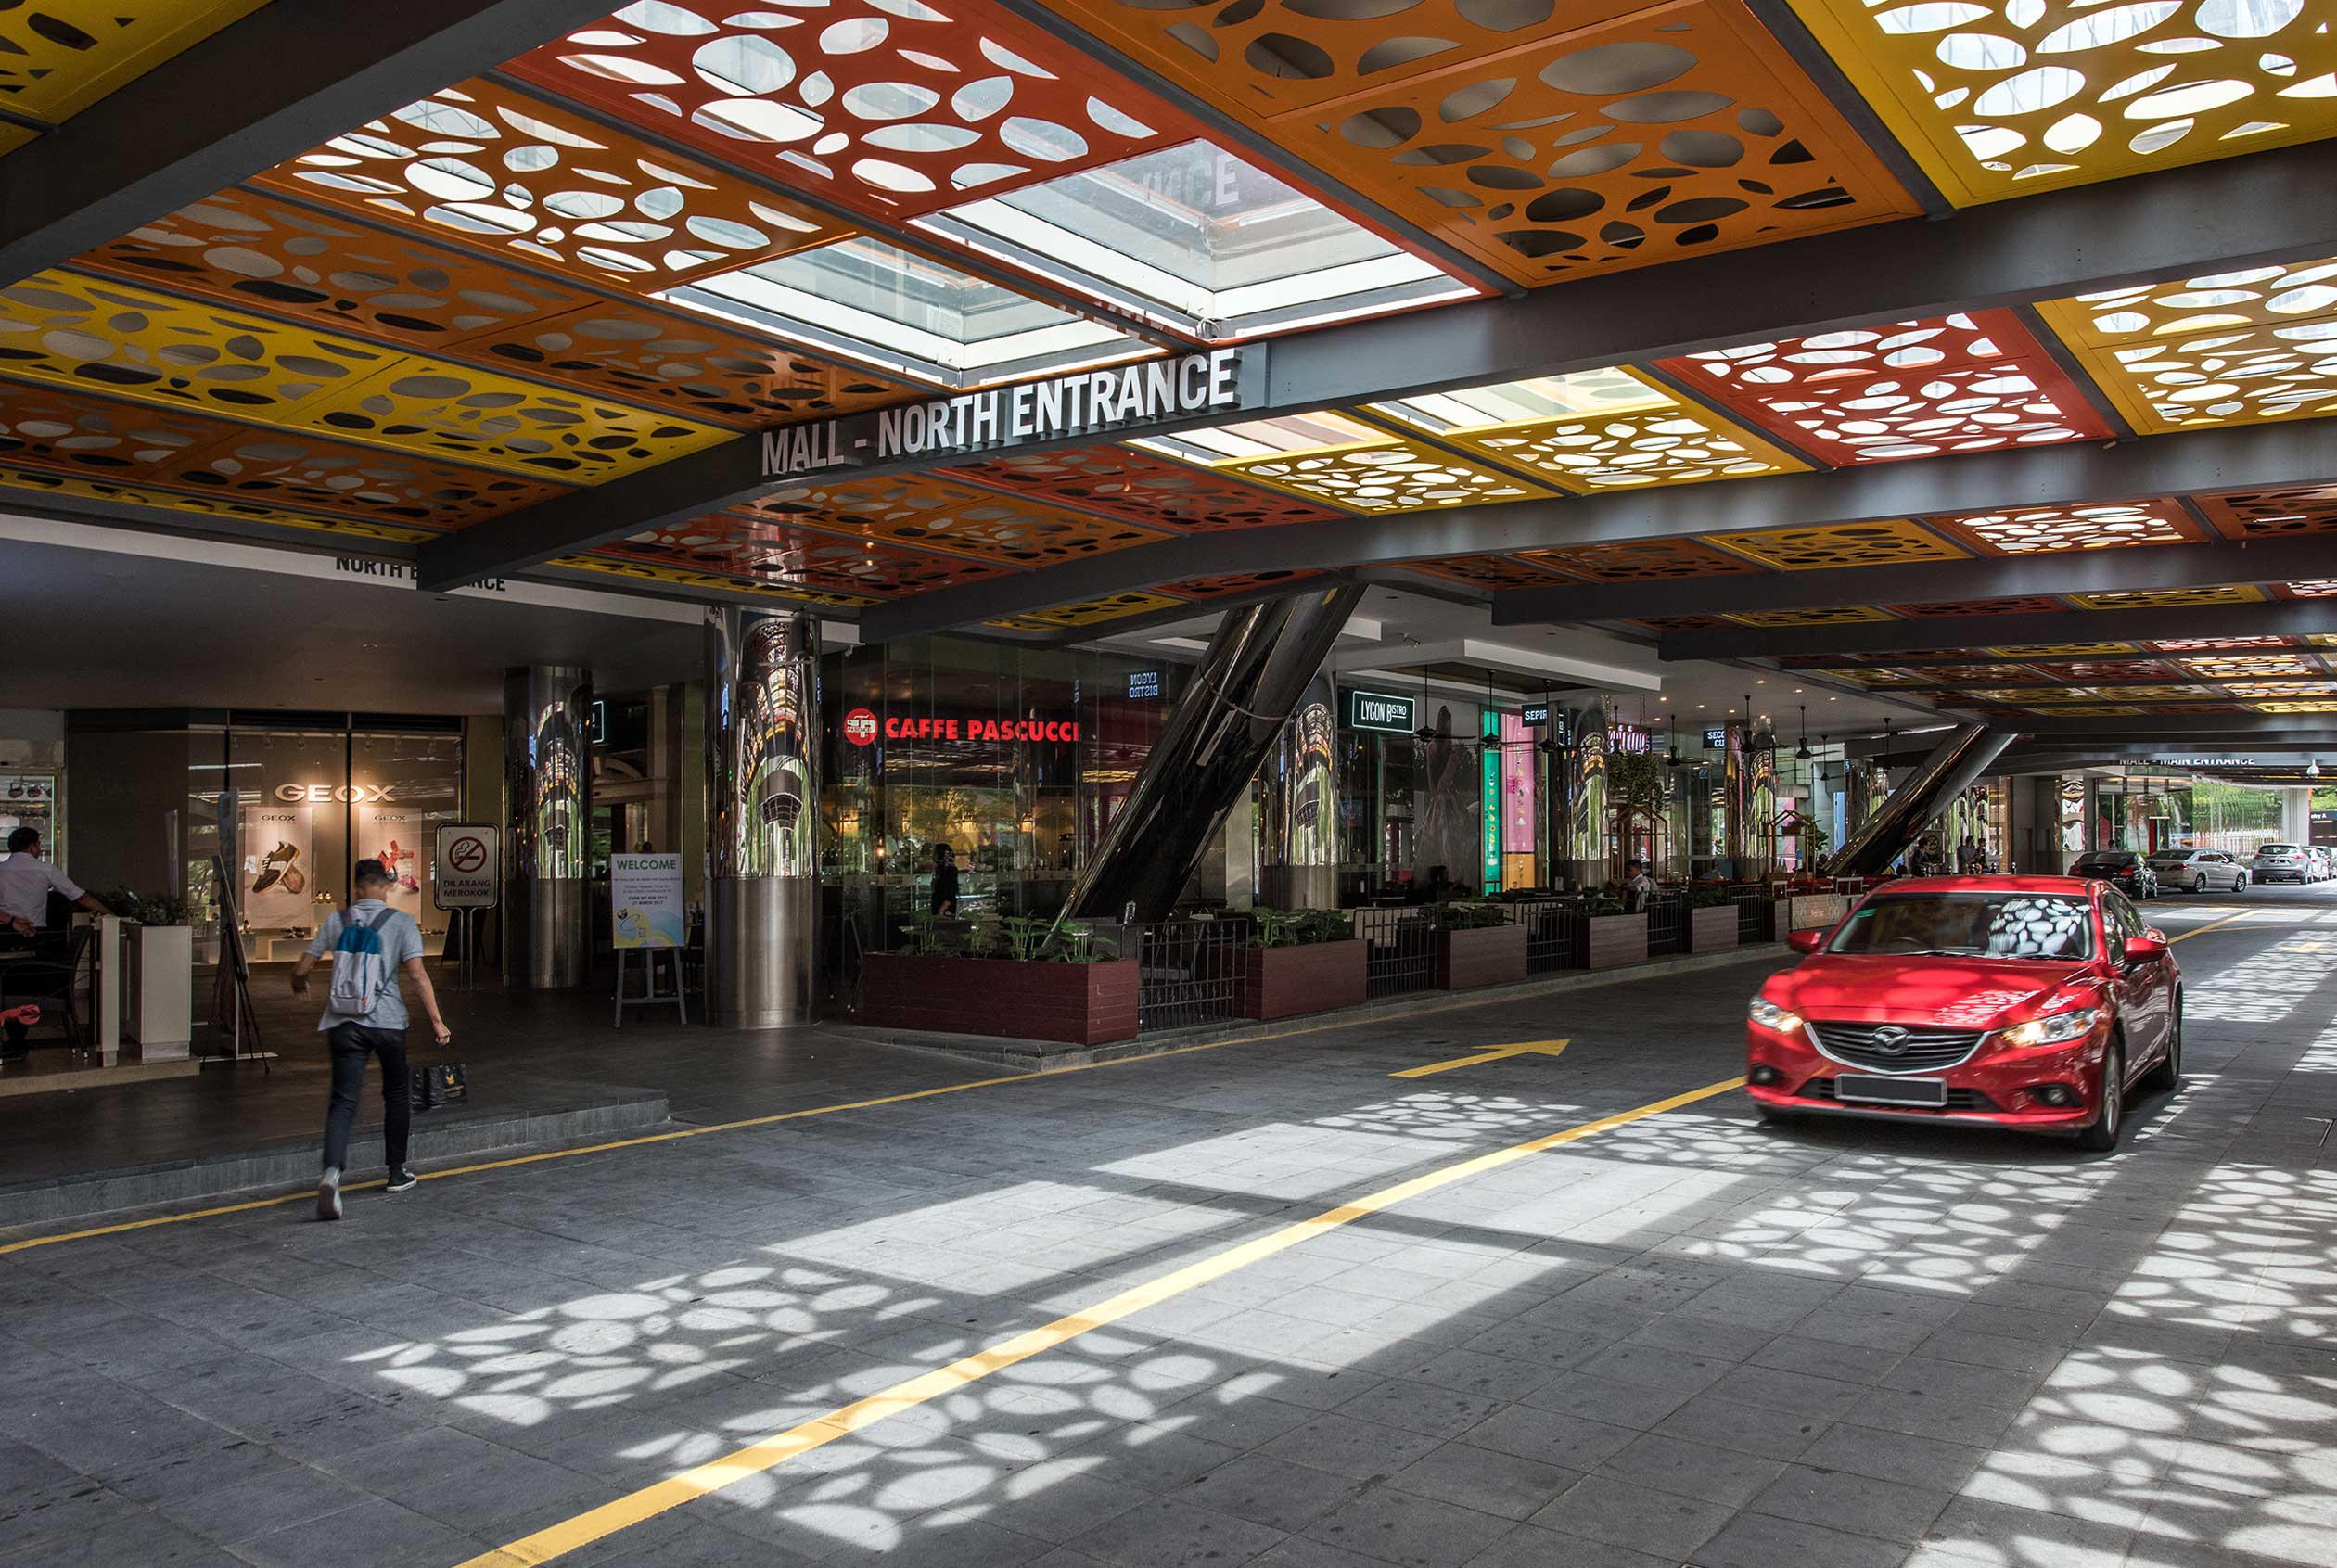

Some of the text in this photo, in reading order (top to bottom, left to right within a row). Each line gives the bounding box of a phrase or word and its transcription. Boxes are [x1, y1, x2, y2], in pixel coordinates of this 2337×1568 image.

[761, 420, 845, 476] MALL
[878, 390, 1000, 458] NORTH
[1012, 348, 1237, 438] ENTRANCE
[336, 556, 402, 579] NORTH
[1360, 700, 1386, 722] LYGON
[885, 717, 1079, 742] CAFFE PASCUCCI
[275, 784, 396, 803] GEOX
[617, 860, 676, 870] WELCOME
[443, 879, 491, 887] DILARANG
[443, 889, 490, 898] MEROKOK
